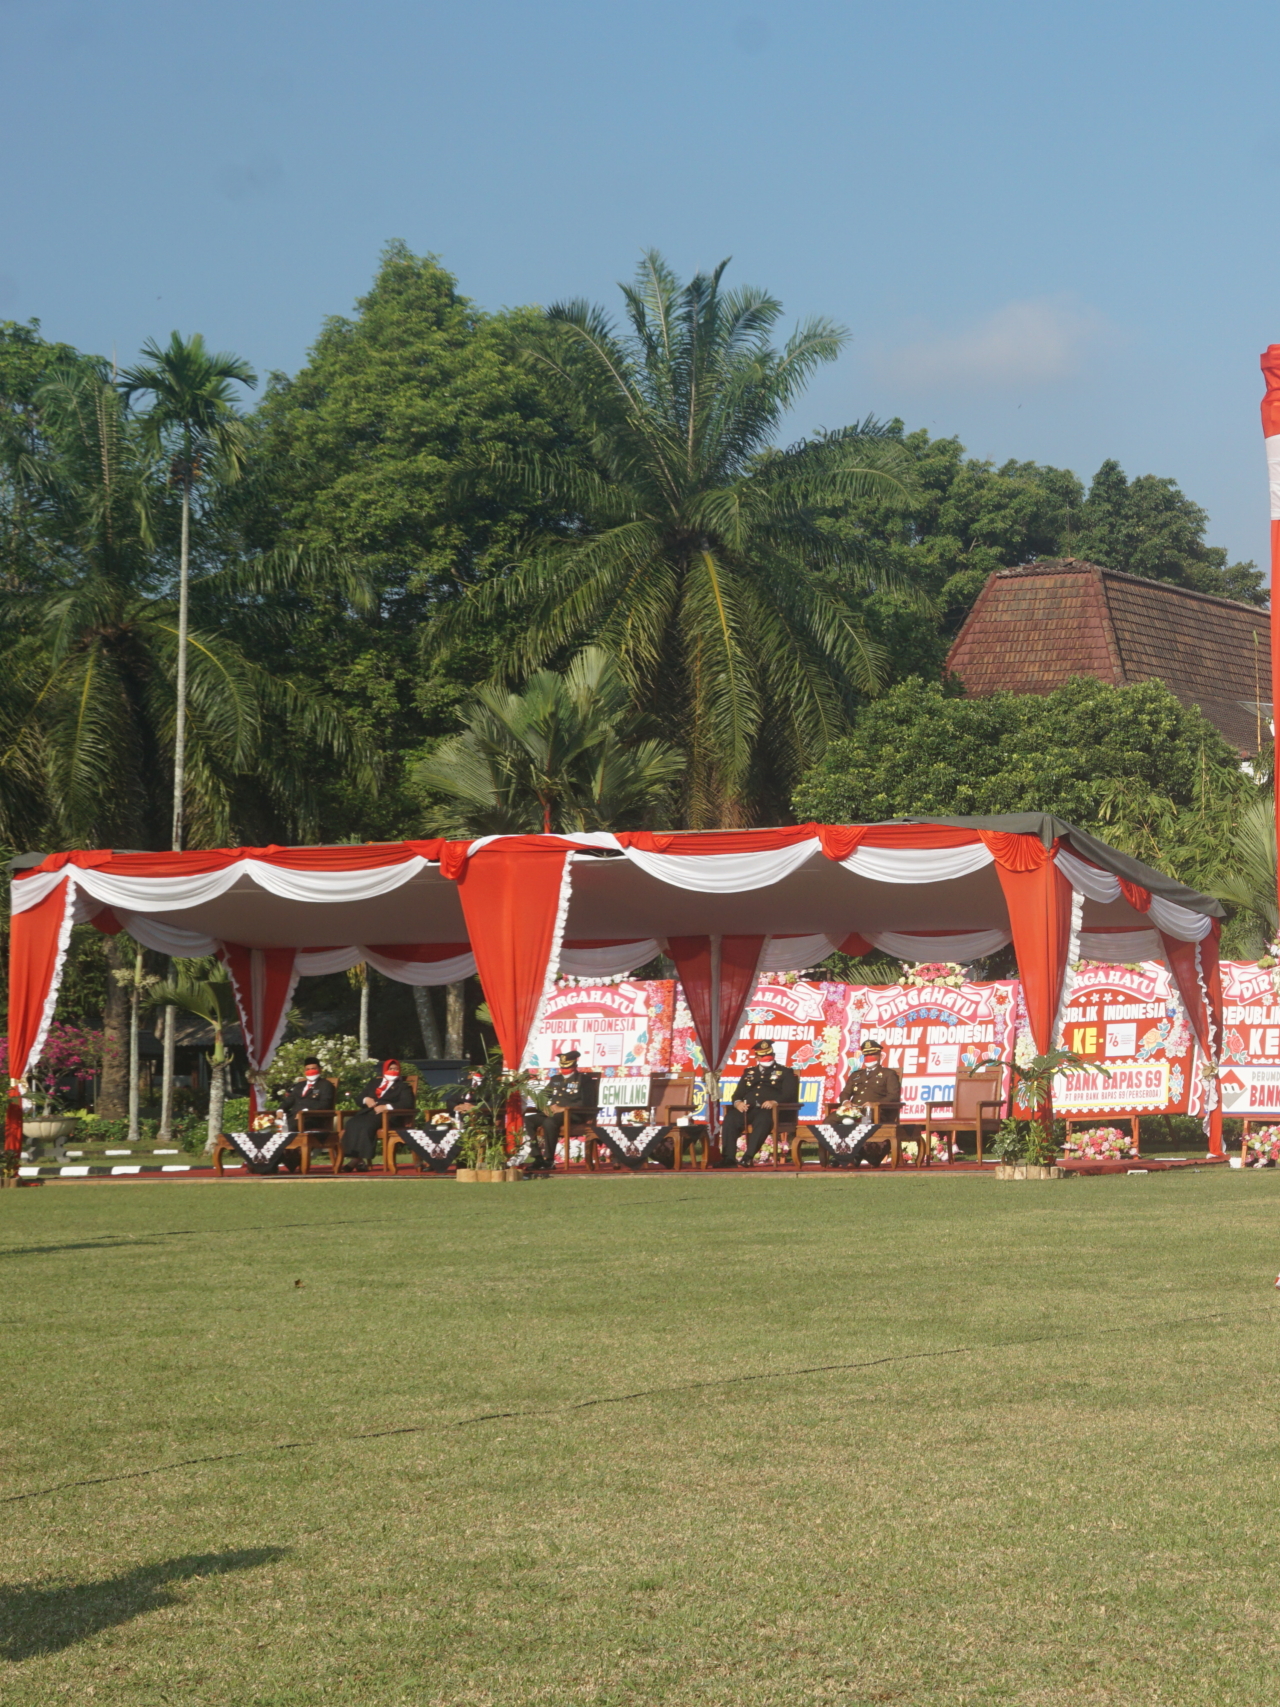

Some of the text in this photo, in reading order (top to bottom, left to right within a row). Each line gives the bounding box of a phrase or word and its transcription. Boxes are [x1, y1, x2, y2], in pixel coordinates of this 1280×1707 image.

[878, 987, 977, 1021] DIRGAHAYU
[1103, 1001, 1166, 1021] INDONESIA
[582, 1018, 636, 1033] INDONESIA
[754, 1025, 815, 1041] INDONESIA
[926, 1024, 994, 1045] INDONESIA
[1065, 1069, 1162, 1092] BANK BAPAS 69
[602, 1084, 647, 1105] GEMILANG
[1085, 1092, 1099, 1101] BANK
[1101, 1091, 1117, 1100] BAPAS
